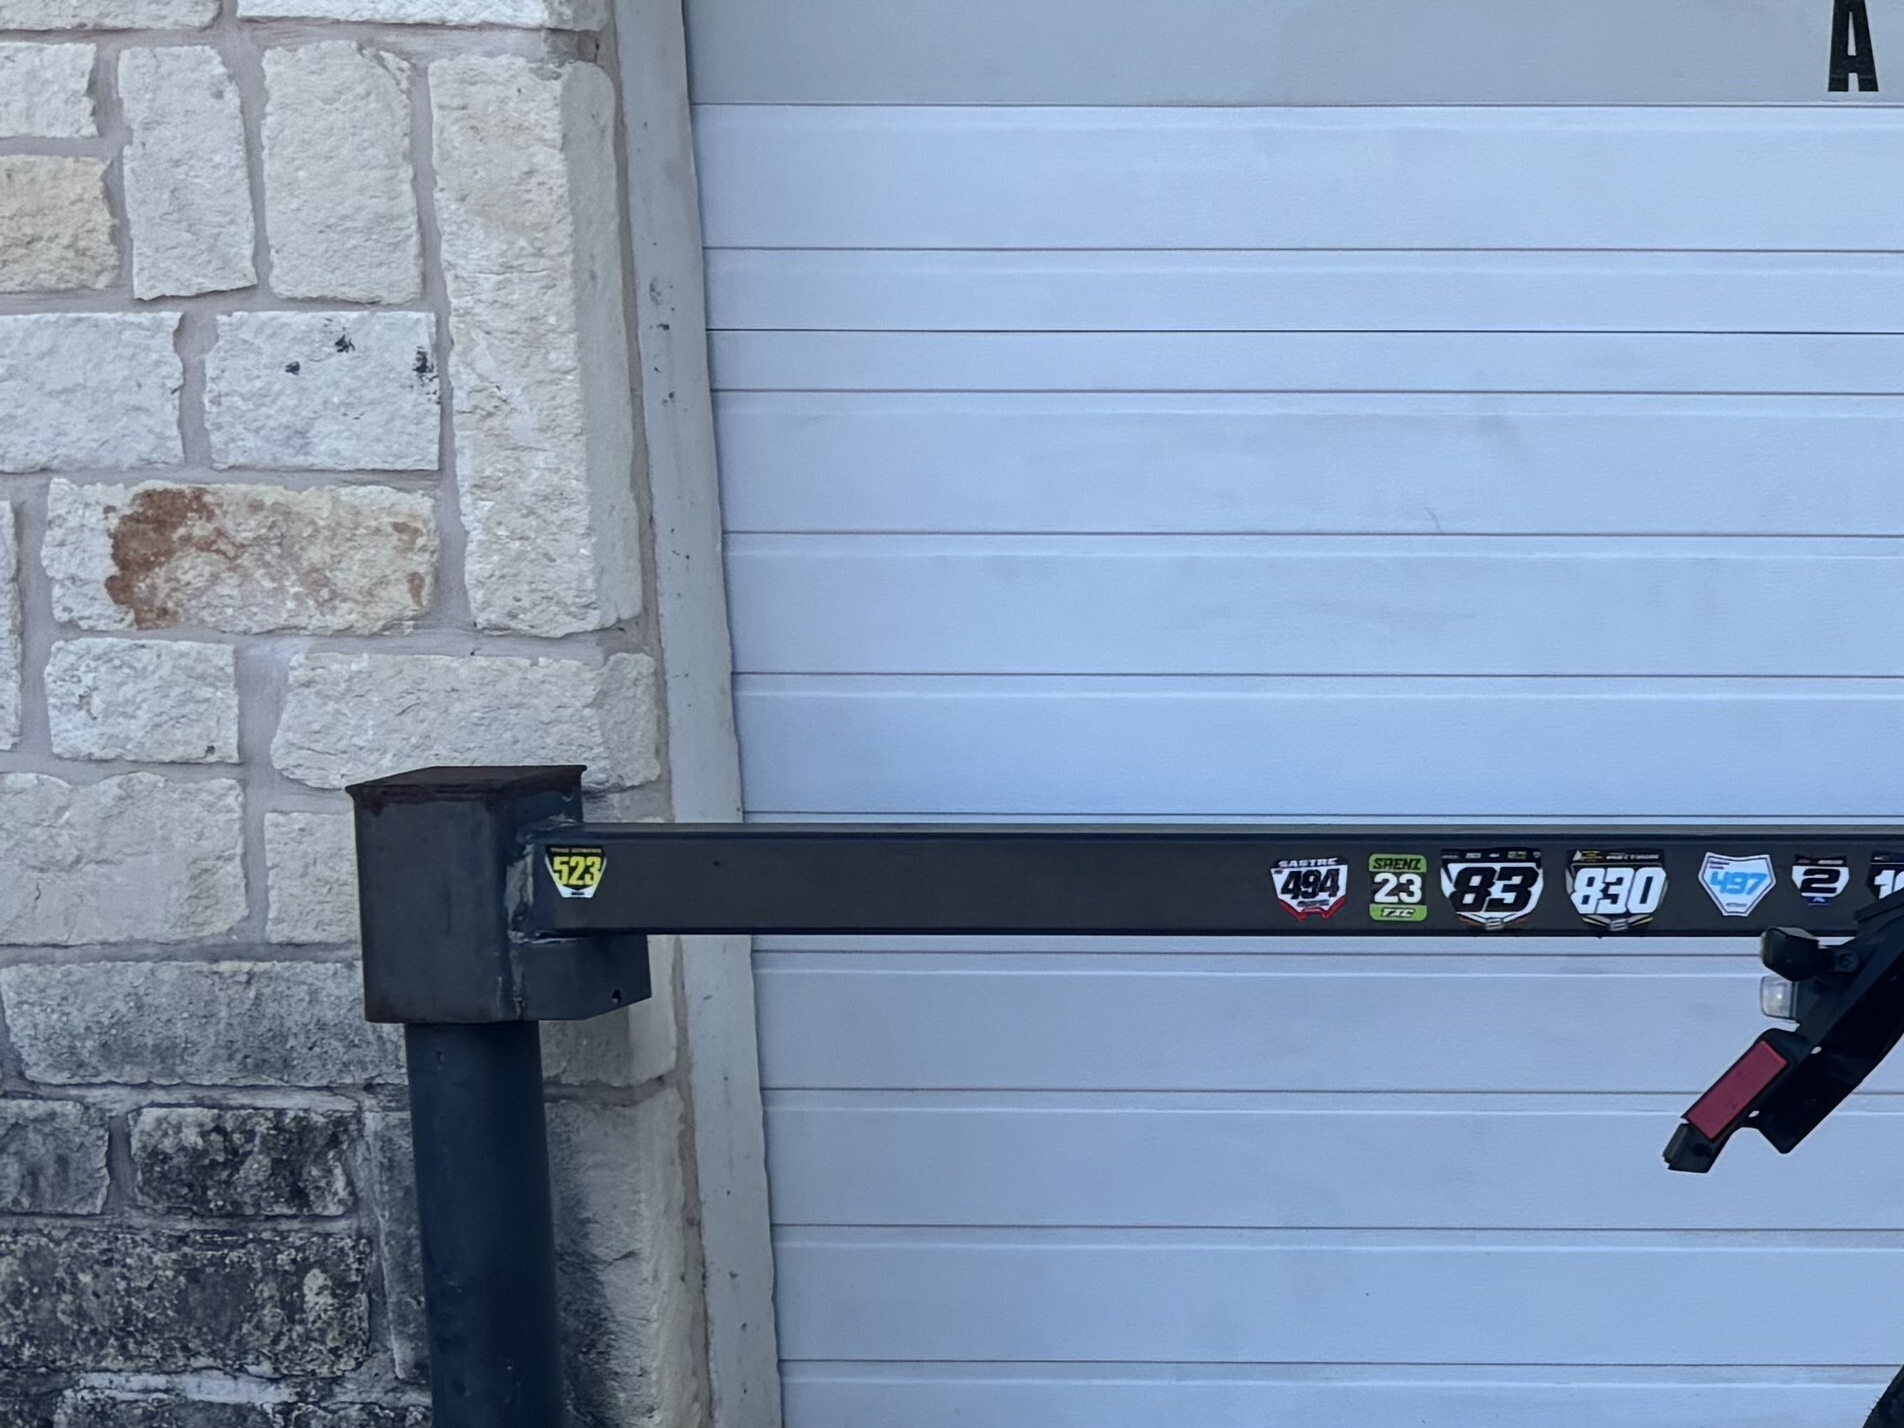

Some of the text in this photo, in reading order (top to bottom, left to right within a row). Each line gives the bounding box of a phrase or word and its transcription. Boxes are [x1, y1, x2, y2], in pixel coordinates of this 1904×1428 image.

[553, 856, 601, 885] 523
[1281, 869, 1340, 899] 494
[1711, 871, 1767, 895] 497
[1801, 868, 1840, 893] 2
[1374, 872, 1422, 903] 23
[1450, 867, 1539, 912] 83
[1570, 867, 1666, 914] 830
